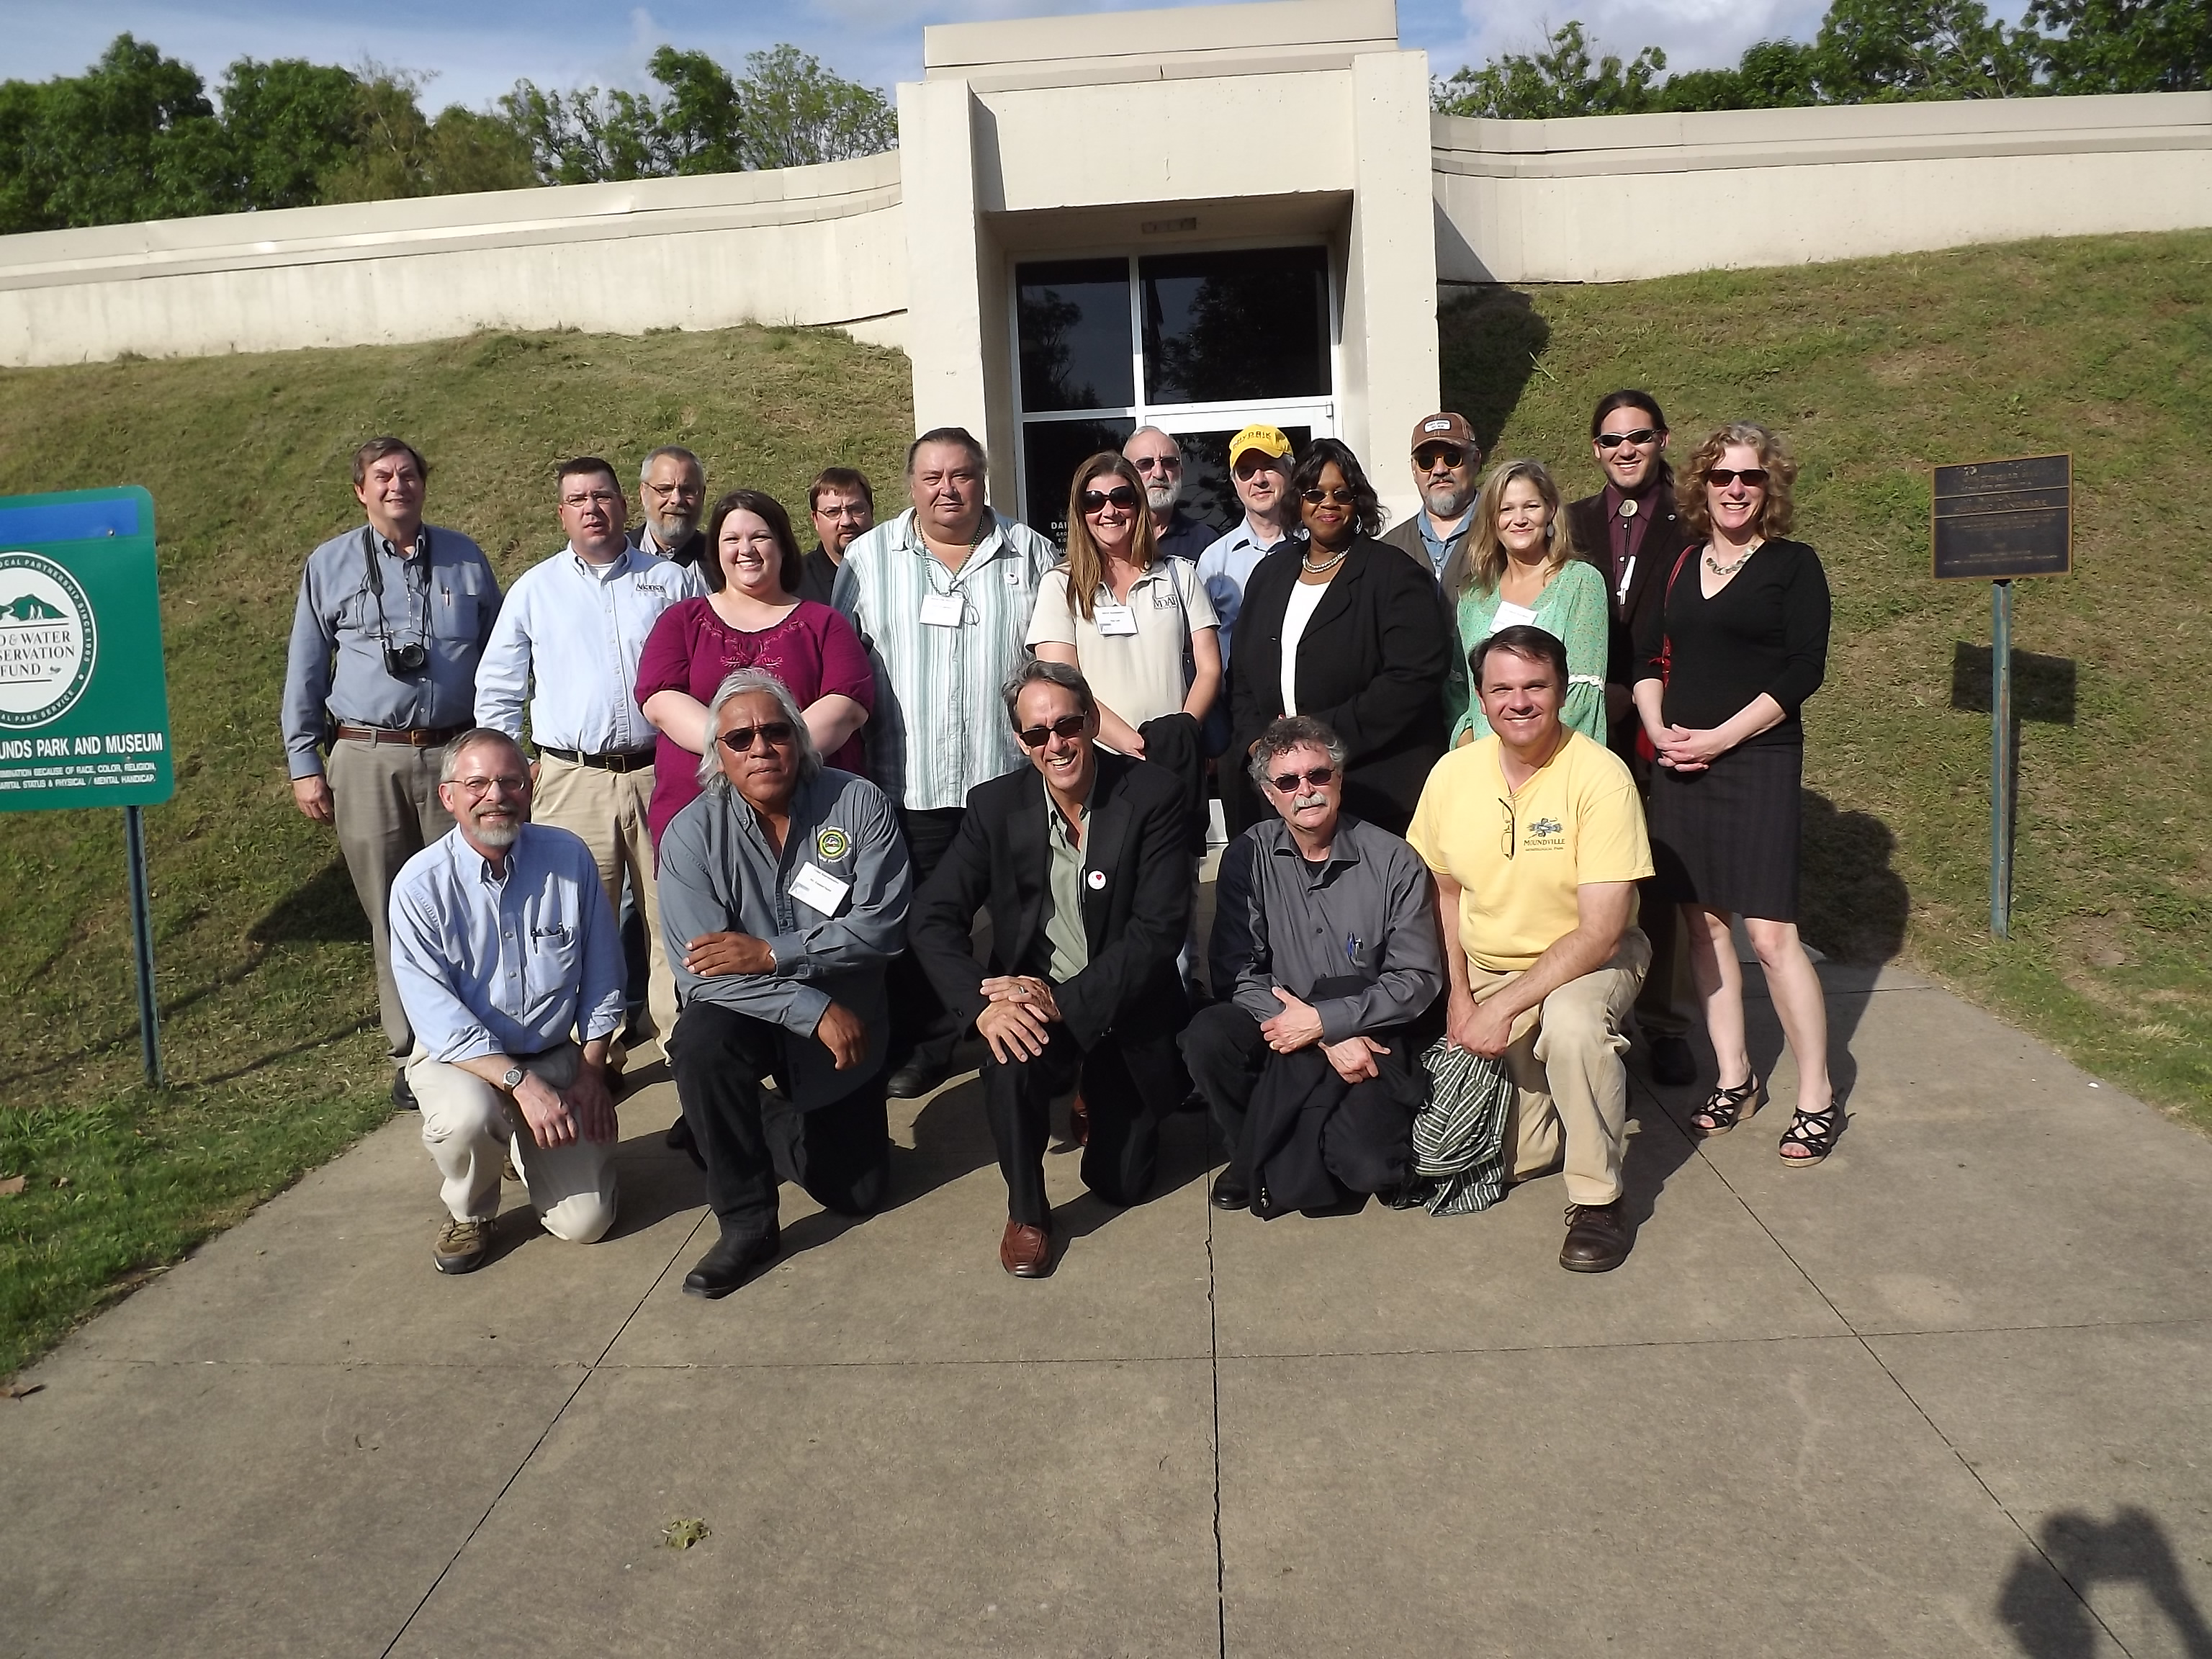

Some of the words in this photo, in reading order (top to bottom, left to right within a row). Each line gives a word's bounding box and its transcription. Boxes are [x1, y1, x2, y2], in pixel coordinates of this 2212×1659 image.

[24, 559, 80, 600] PARTNERSHIP
[77, 602, 91, 633] SINCE
[9, 634, 17, 646] &
[21, 631, 71, 644] WATER
[0, 663, 41, 677] FUND
[40, 689, 74, 718] SERVICE
[0, 739, 32, 760] UNDS
[37, 737, 70, 757] PARK
[75, 736, 101, 755] AND
[105, 732, 163, 754] MUSEUM
[33, 766, 63, 776] BECAUSE
[65, 765, 74, 775] OF
[97, 763, 122, 773] COLOR,
[22, 779, 46, 788] STATUS
[55, 777, 86, 787] PHYSICAL
[94, 775, 120, 785] MENTAL
